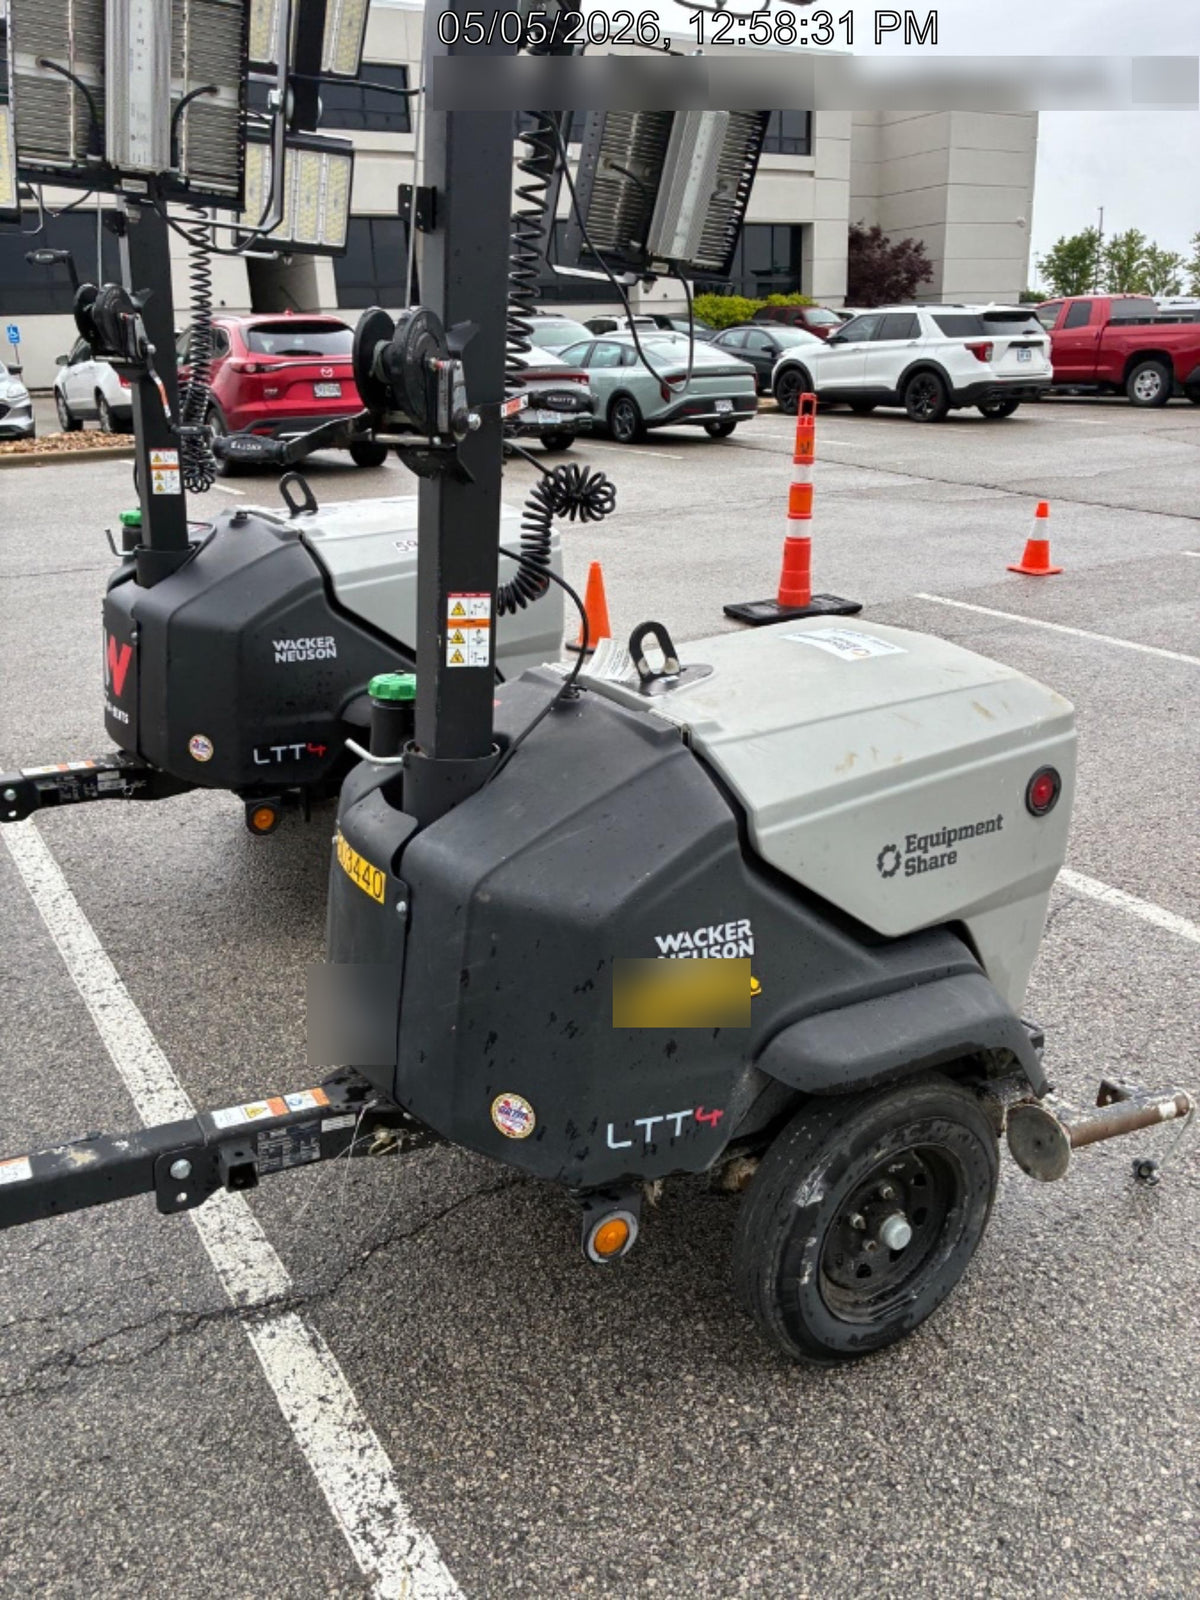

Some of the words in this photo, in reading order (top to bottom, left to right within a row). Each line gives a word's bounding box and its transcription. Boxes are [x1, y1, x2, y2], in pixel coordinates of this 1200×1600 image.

[272, 636, 336, 652] WACKER
[274, 646, 337, 663] NEUSON
[253, 743, 326, 765] LTT4
[905, 813, 1004, 854] Equipment
[904, 850, 958, 877] Share
[654, 919, 753, 954] WACKER
[607, 1105, 724, 1149] LTT4
